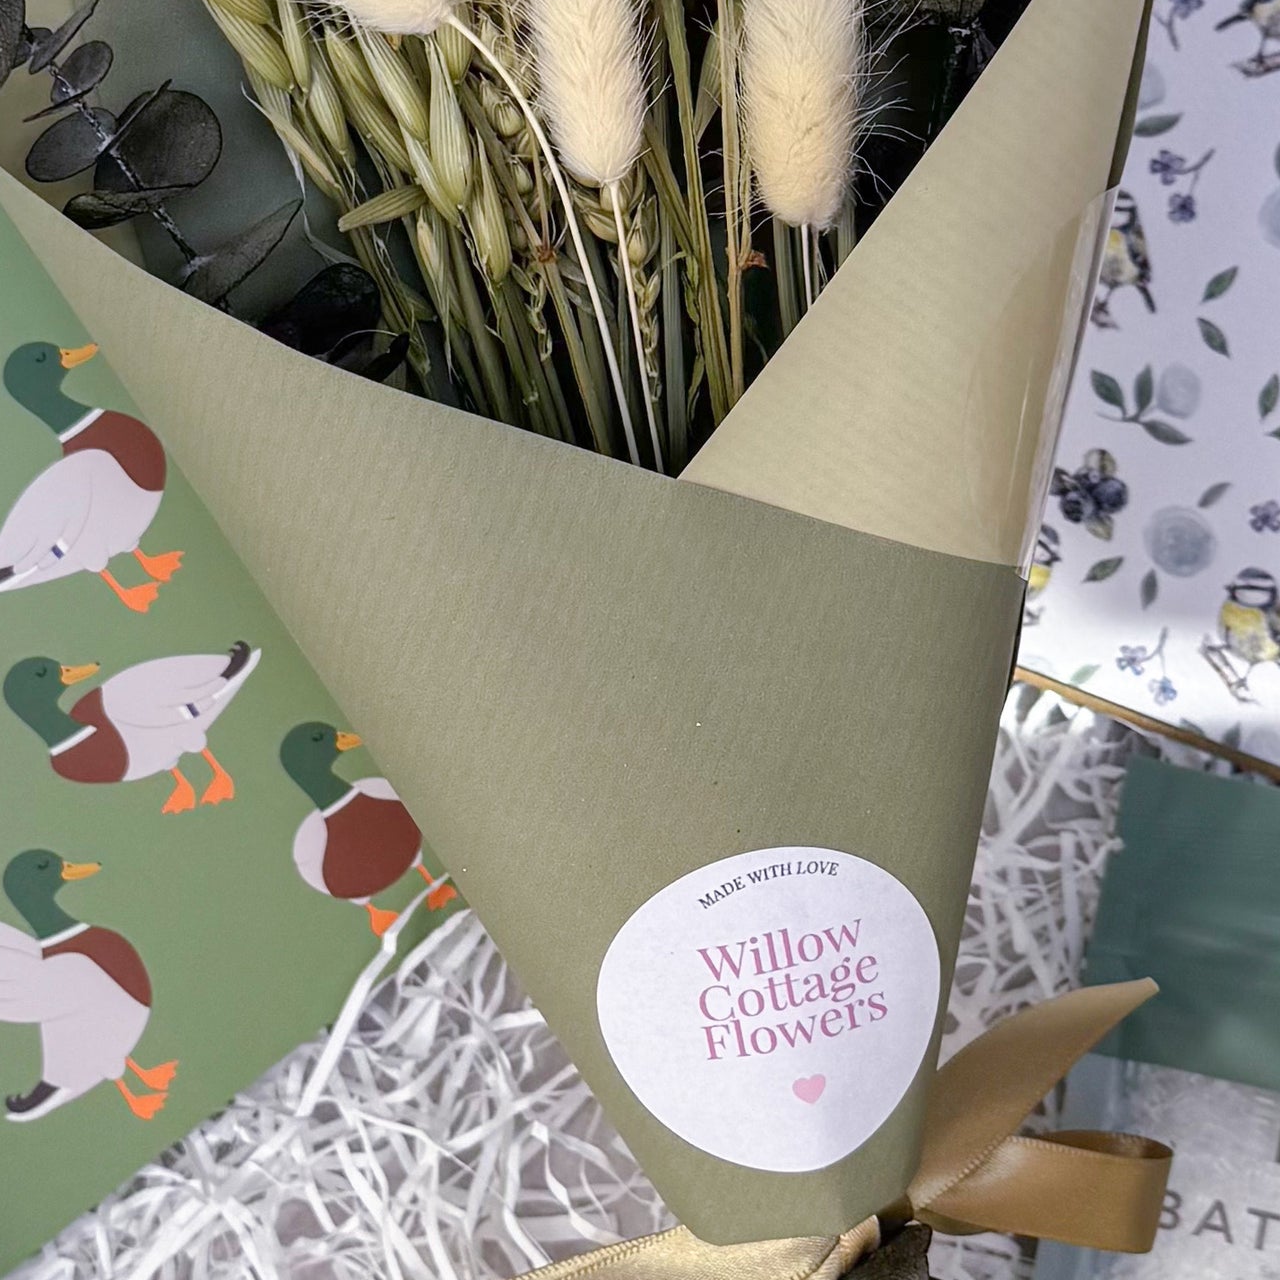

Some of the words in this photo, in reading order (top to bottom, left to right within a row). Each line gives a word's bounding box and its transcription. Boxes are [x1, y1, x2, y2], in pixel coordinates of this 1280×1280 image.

[698, 876, 746, 909] MADE
[747, 862, 792, 884] WITH
[796, 860, 839, 877] LOVE
[696, 918, 862, 981] Willow
[698, 954, 879, 1022] Cottage
[701, 991, 889, 1060] Flowers
